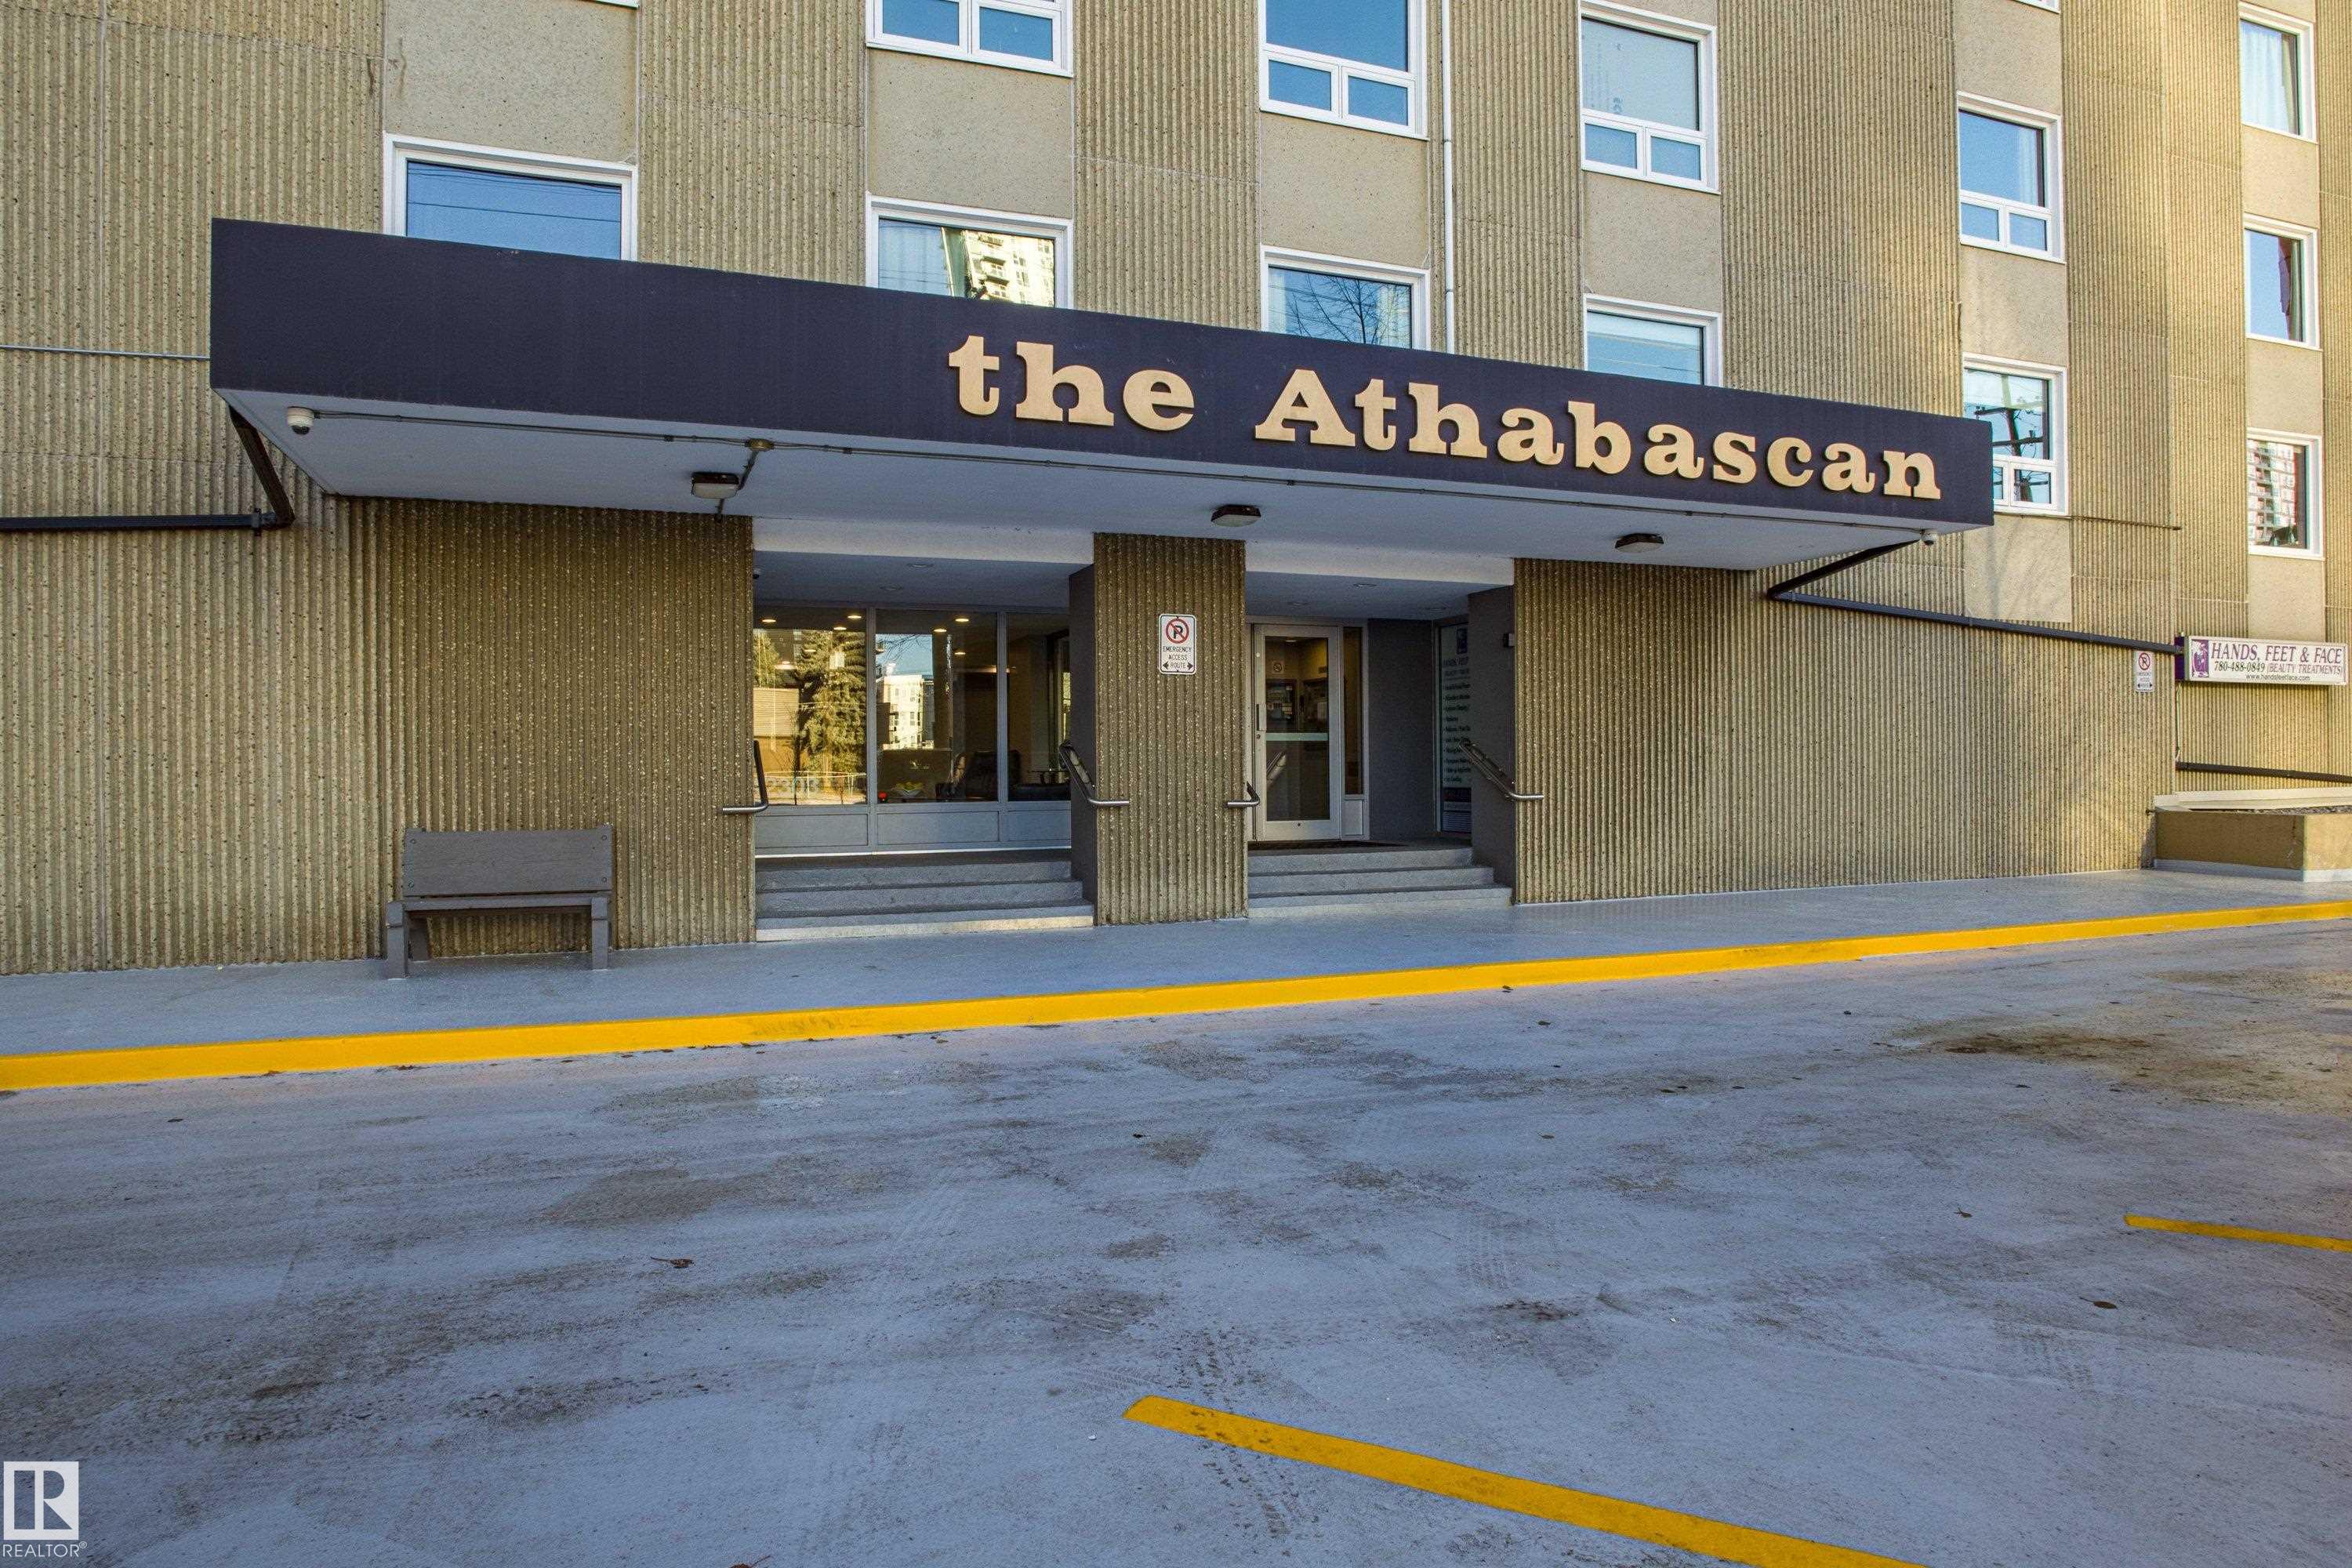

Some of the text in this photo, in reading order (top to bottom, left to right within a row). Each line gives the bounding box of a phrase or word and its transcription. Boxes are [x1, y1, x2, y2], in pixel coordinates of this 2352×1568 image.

[949, 335, 1942, 500] the Athabascan
[2211, 642, 2342, 664] HANDS, FEET & FACE
[2214, 660, 2343, 675] 780-488-0849 (BEAUTY TREATMENTS)
